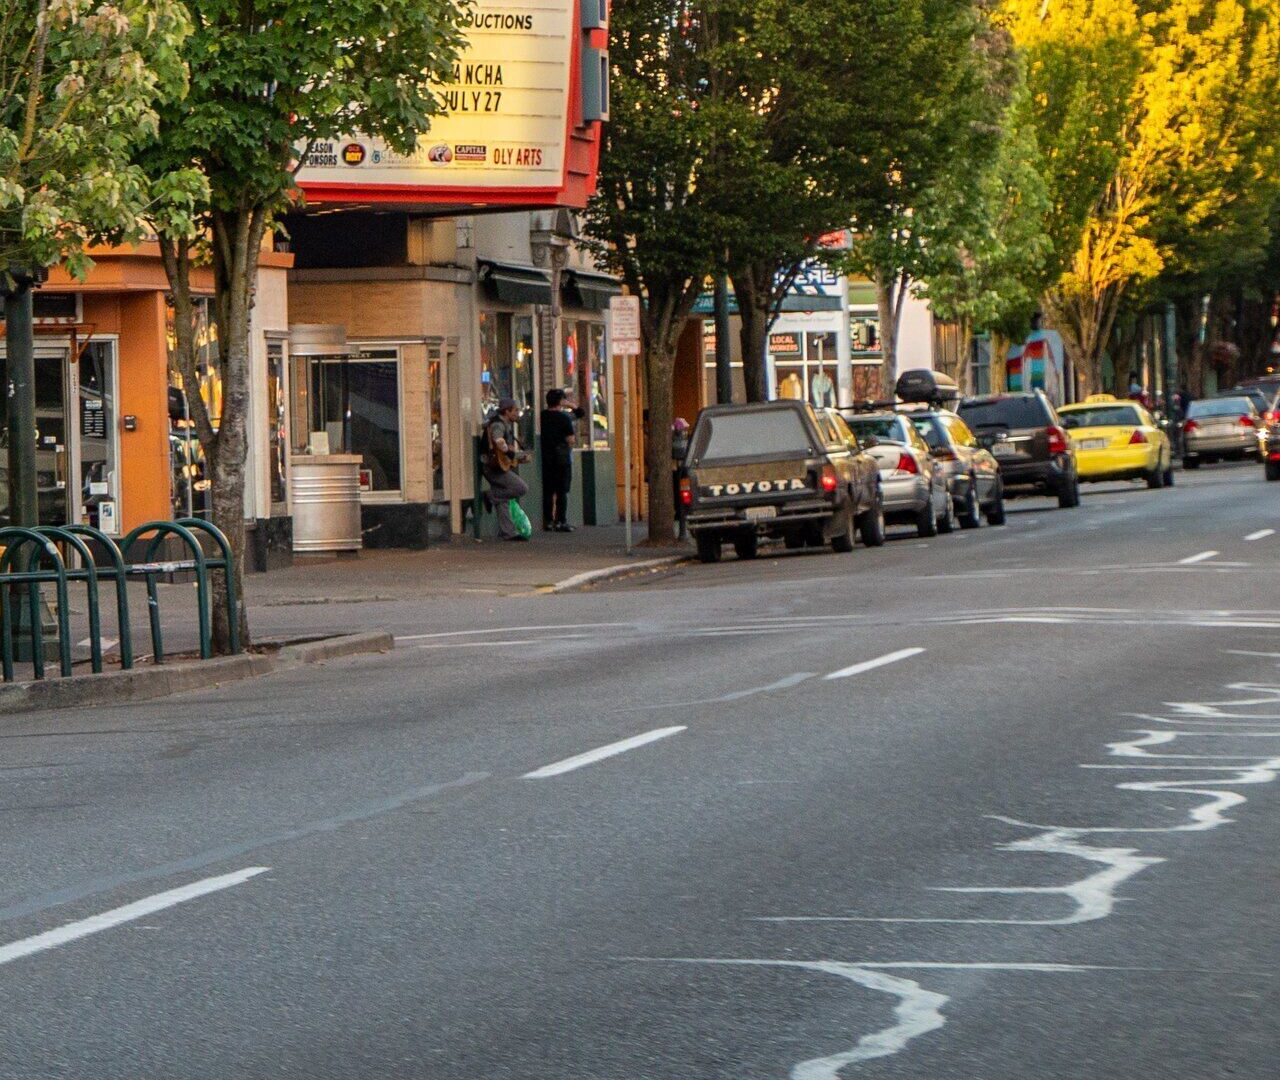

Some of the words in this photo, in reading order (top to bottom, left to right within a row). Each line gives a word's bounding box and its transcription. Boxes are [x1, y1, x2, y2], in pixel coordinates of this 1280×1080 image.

[484, 91, 502, 112] 27
[310, 142, 333, 153] EASON
[455, 145, 486, 154] CAPITAL
[493, 148, 513, 165] OLY
[516, 149, 542, 166] ARTS
[771, 335, 794, 344] LOCAL
[770, 343, 798, 352] WORKERS
[709, 479, 806, 497] TOYOTA
